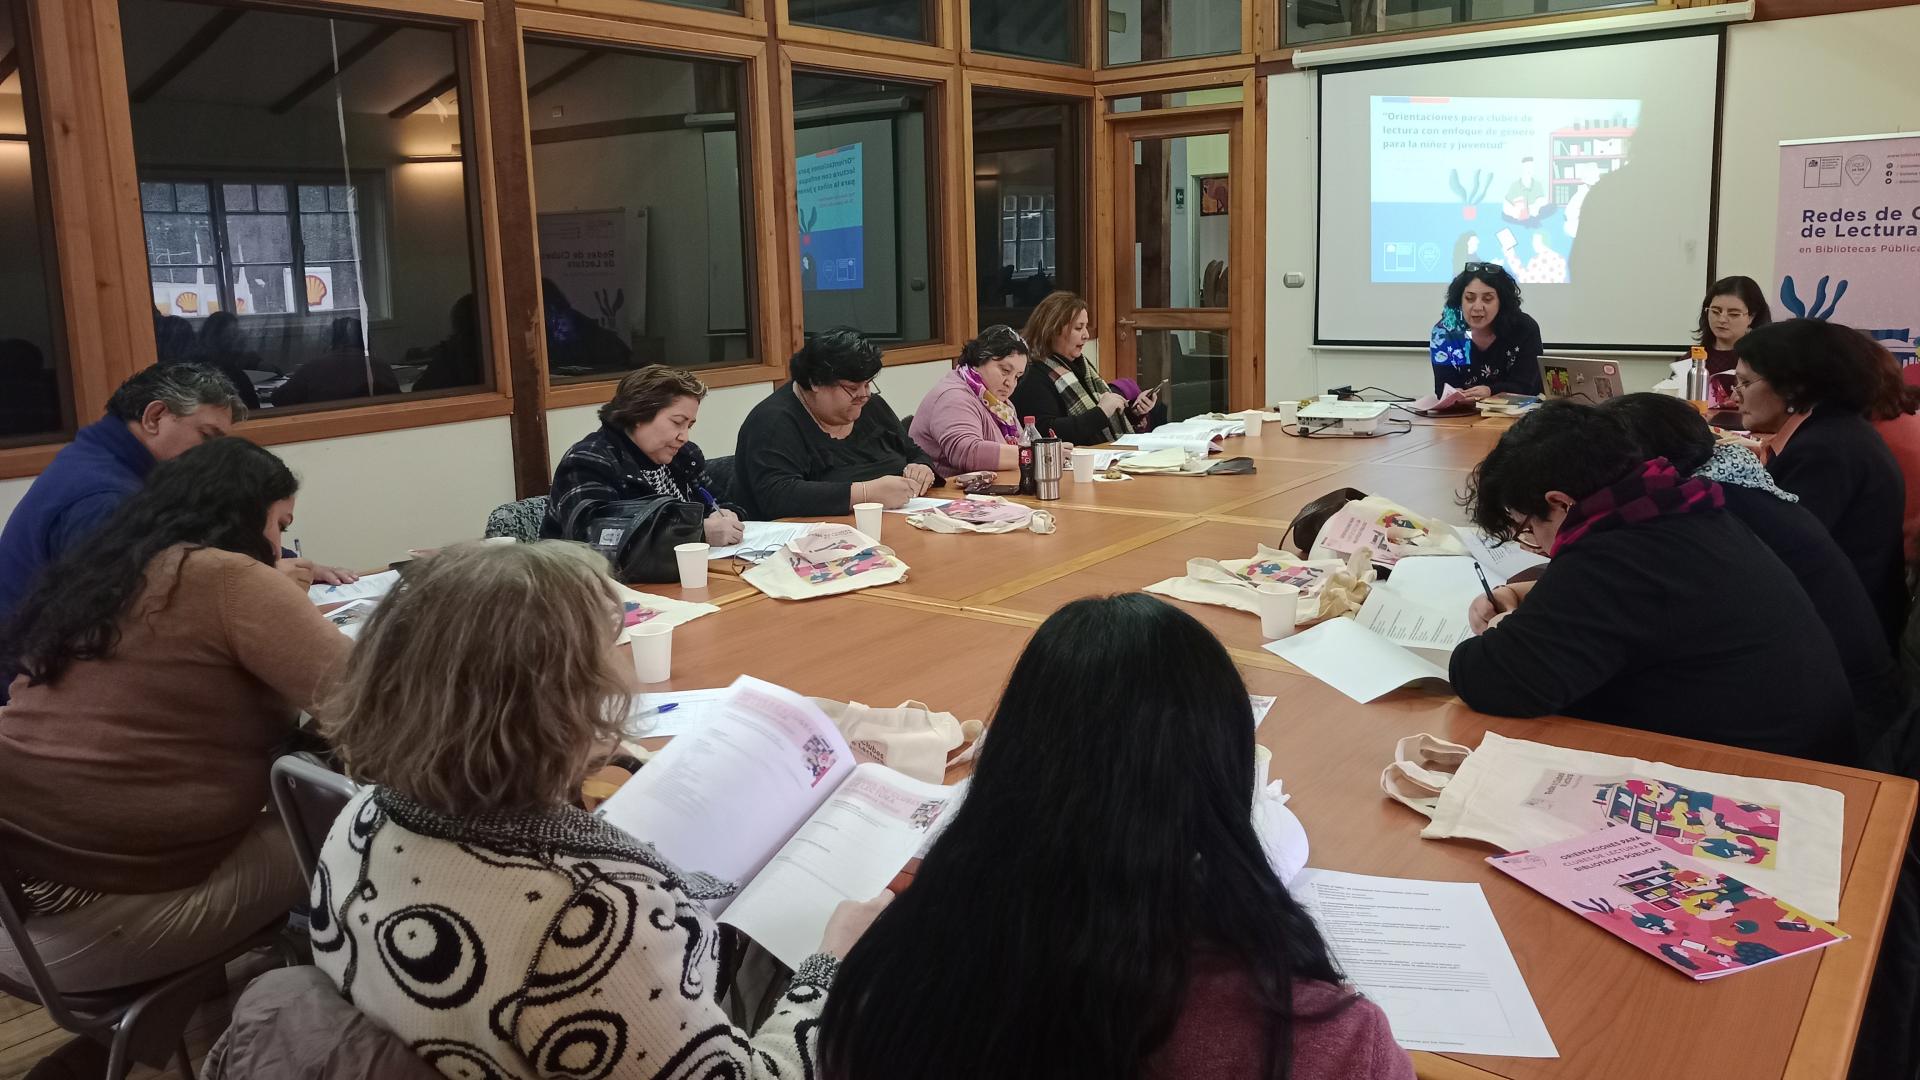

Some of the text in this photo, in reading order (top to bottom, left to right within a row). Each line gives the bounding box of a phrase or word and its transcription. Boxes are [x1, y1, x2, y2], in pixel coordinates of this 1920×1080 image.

[1461, 114, 1484, 123] para
[1382, 126, 1419, 135] lectura
[1421, 127, 1439, 135] con
[1442, 126, 1482, 137] enfoque
[1382, 141, 1406, 150] para
[1408, 139, 1417, 148] la
[1449, 141, 1456, 150] y
[1802, 208, 1867, 223] Redes
[1875, 206, 1902, 221] de
[1801, 223, 1918, 238] de Lectura
[1799, 246, 1812, 254] en
[1815, 244, 1877, 254] Bibliotecas
[1639, 840, 1652, 848] EN
